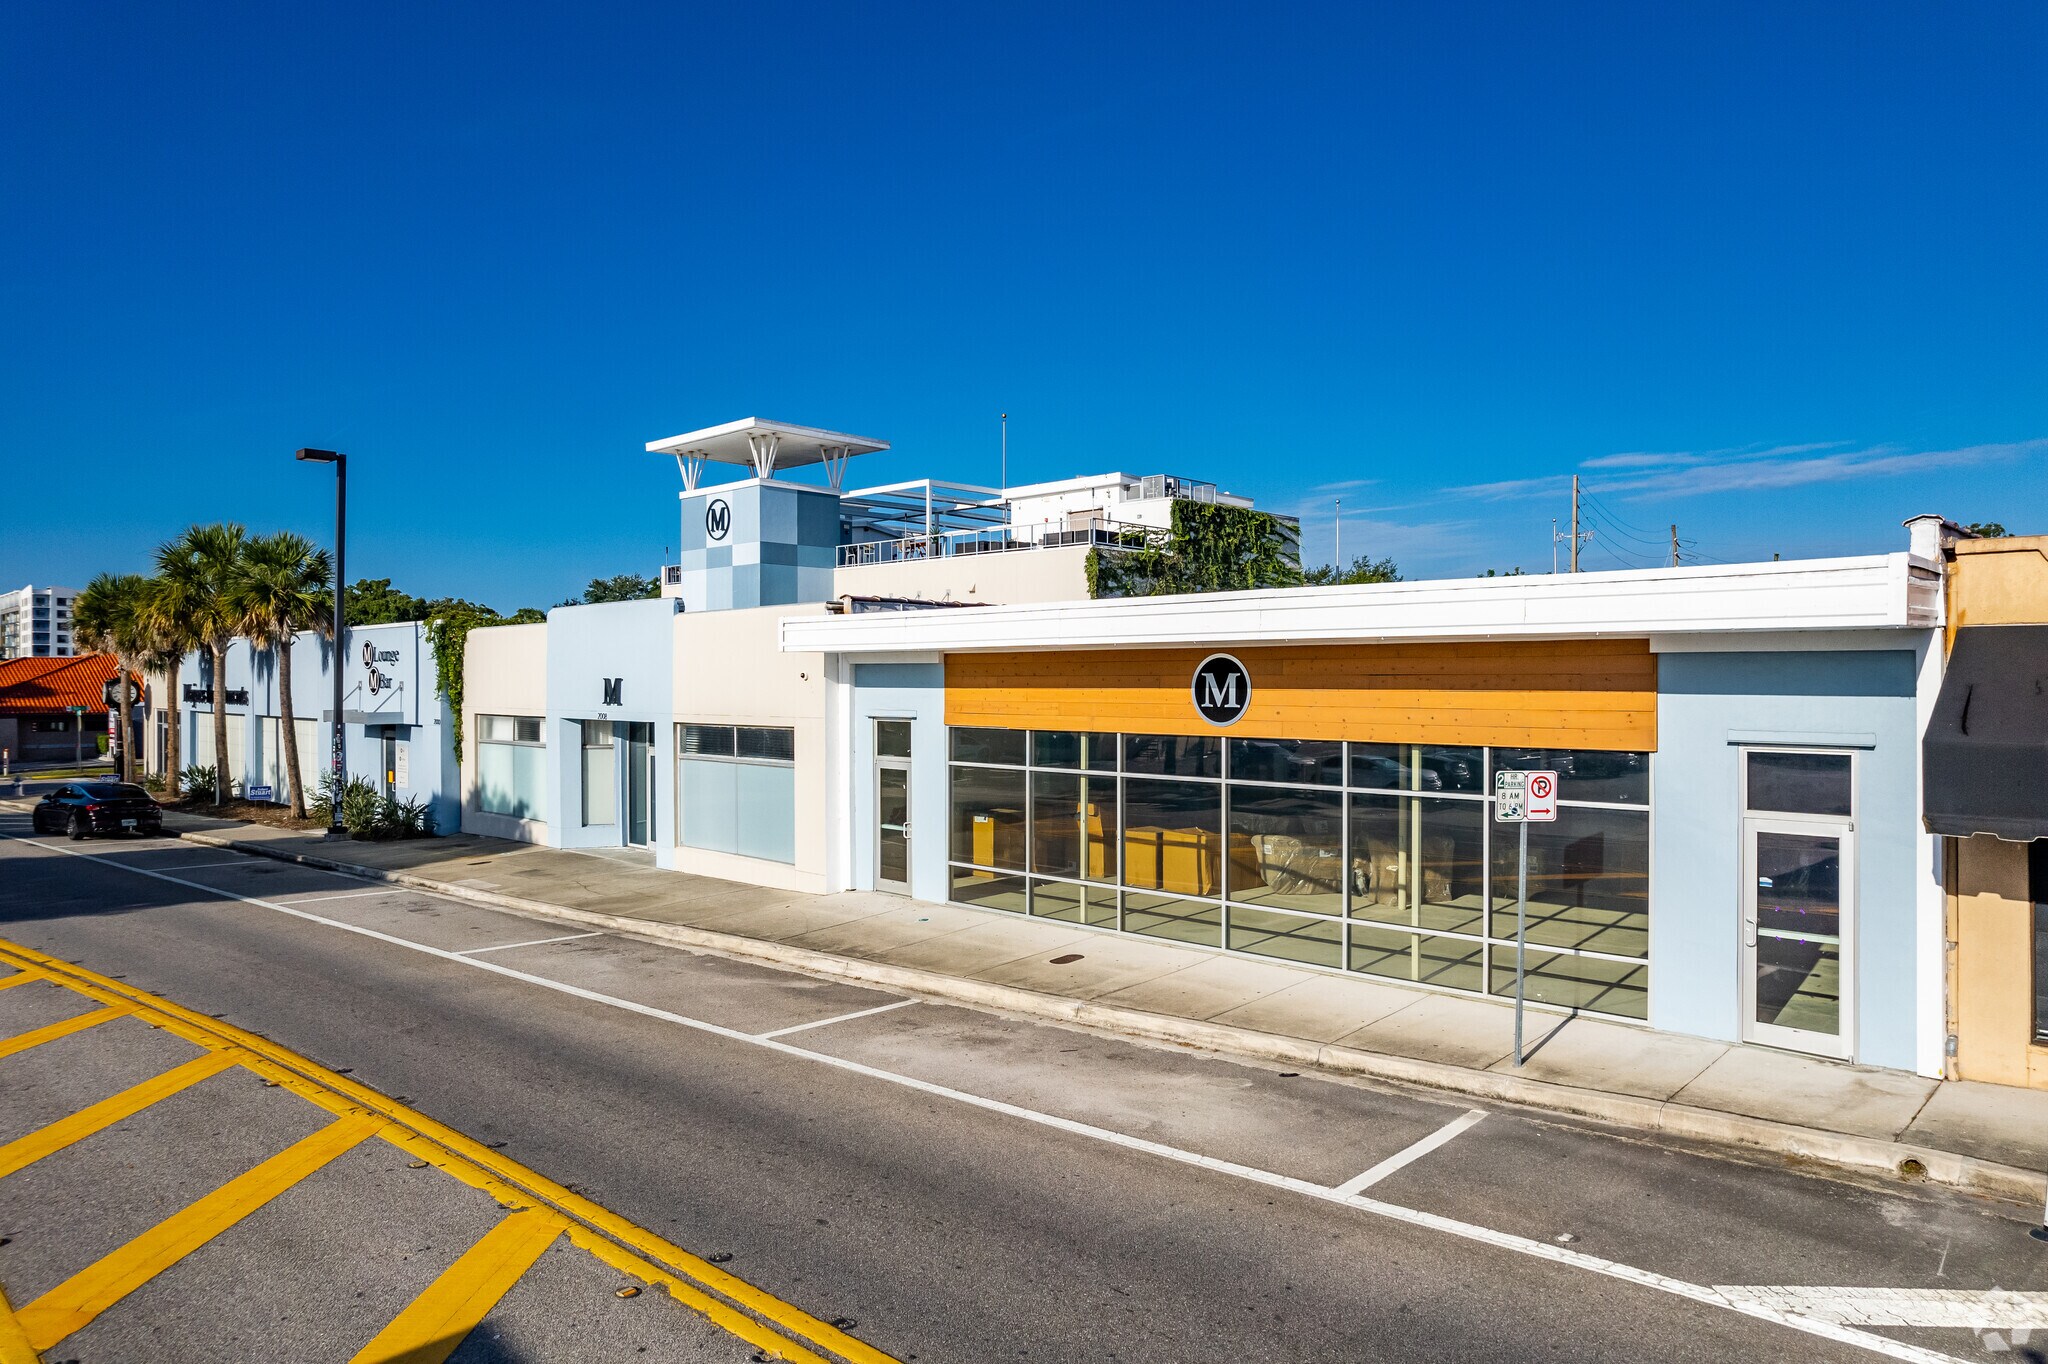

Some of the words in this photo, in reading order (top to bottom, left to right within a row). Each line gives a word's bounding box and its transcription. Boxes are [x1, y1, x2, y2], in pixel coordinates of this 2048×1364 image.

[710, 507, 727, 532] M
[373, 647, 399, 666] Lounge
[379, 673, 393, 689] Bar
[1201, 673, 1240, 708] M
[602, 678, 623, 706] M
[1498, 775, 1504, 787] 2
[1515, 802, 1523, 810] PM
